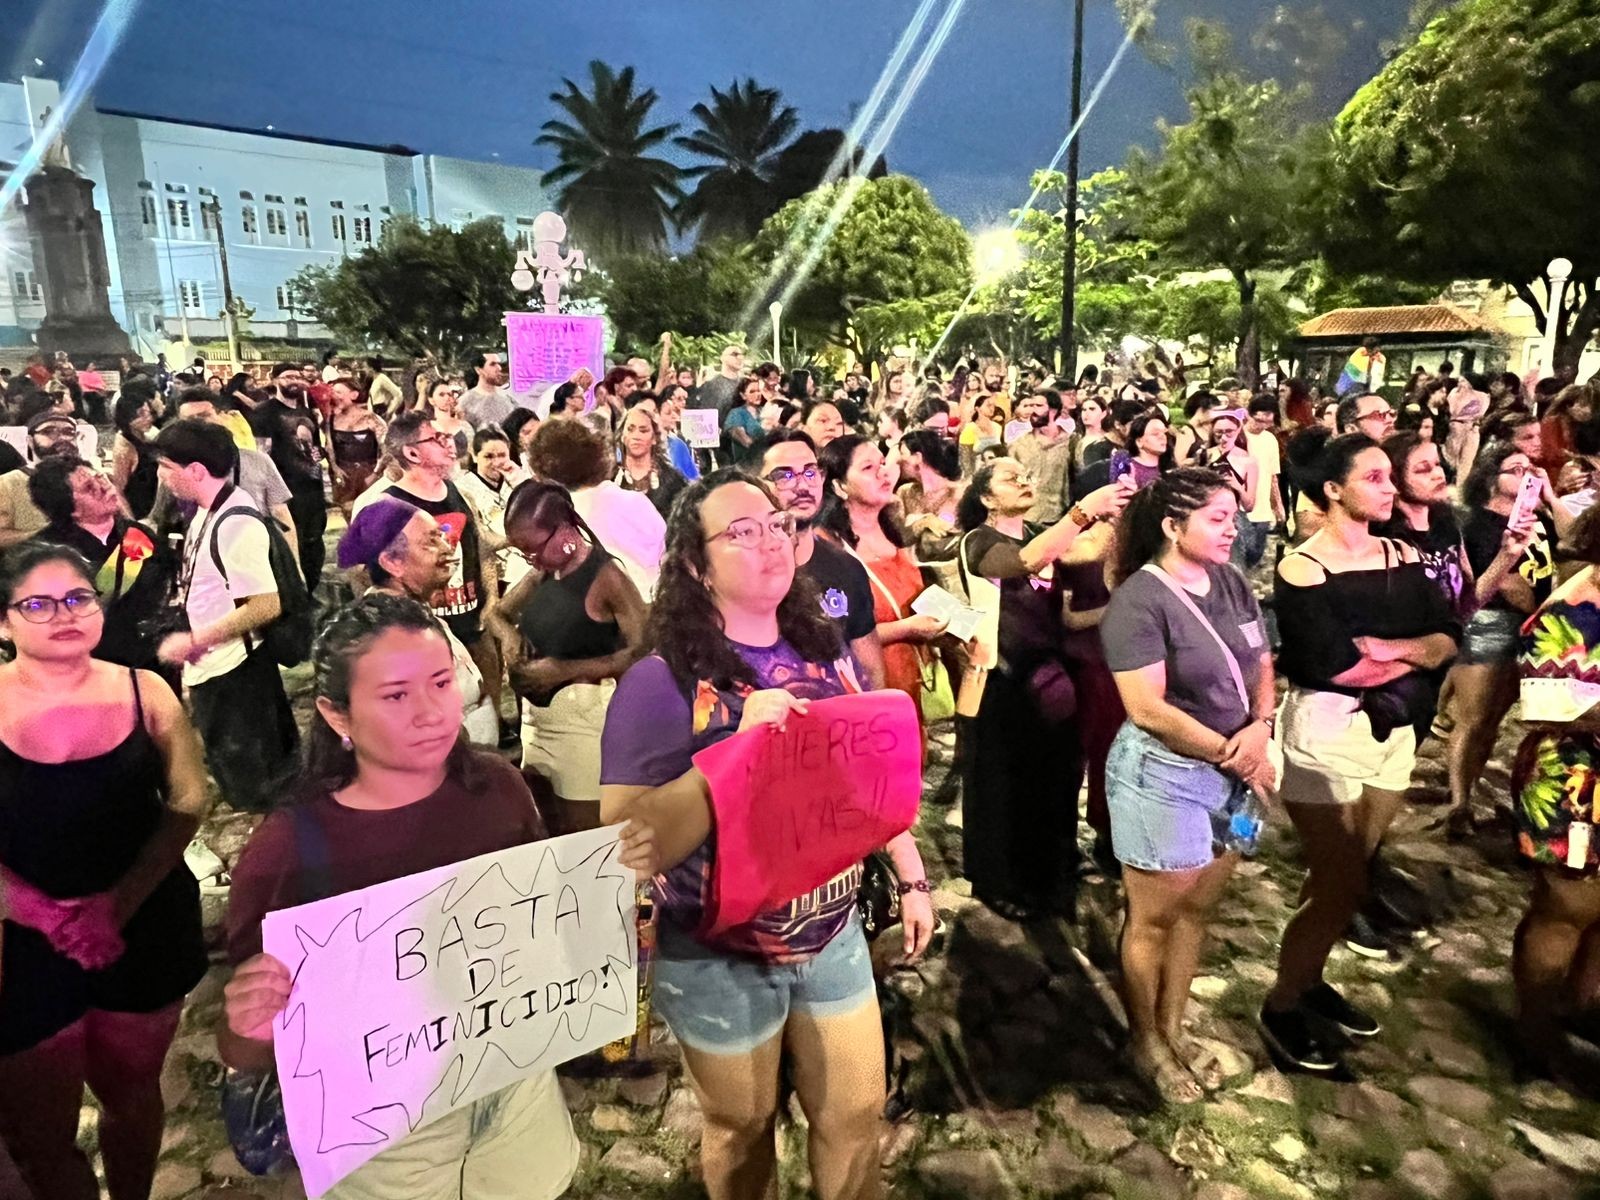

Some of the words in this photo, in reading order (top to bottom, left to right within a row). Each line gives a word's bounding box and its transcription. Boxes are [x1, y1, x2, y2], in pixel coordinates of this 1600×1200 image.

[395, 884, 581, 981] BASTA
[464, 949, 522, 1002] DE
[364, 964, 610, 1082] FEMINICIDIO!
